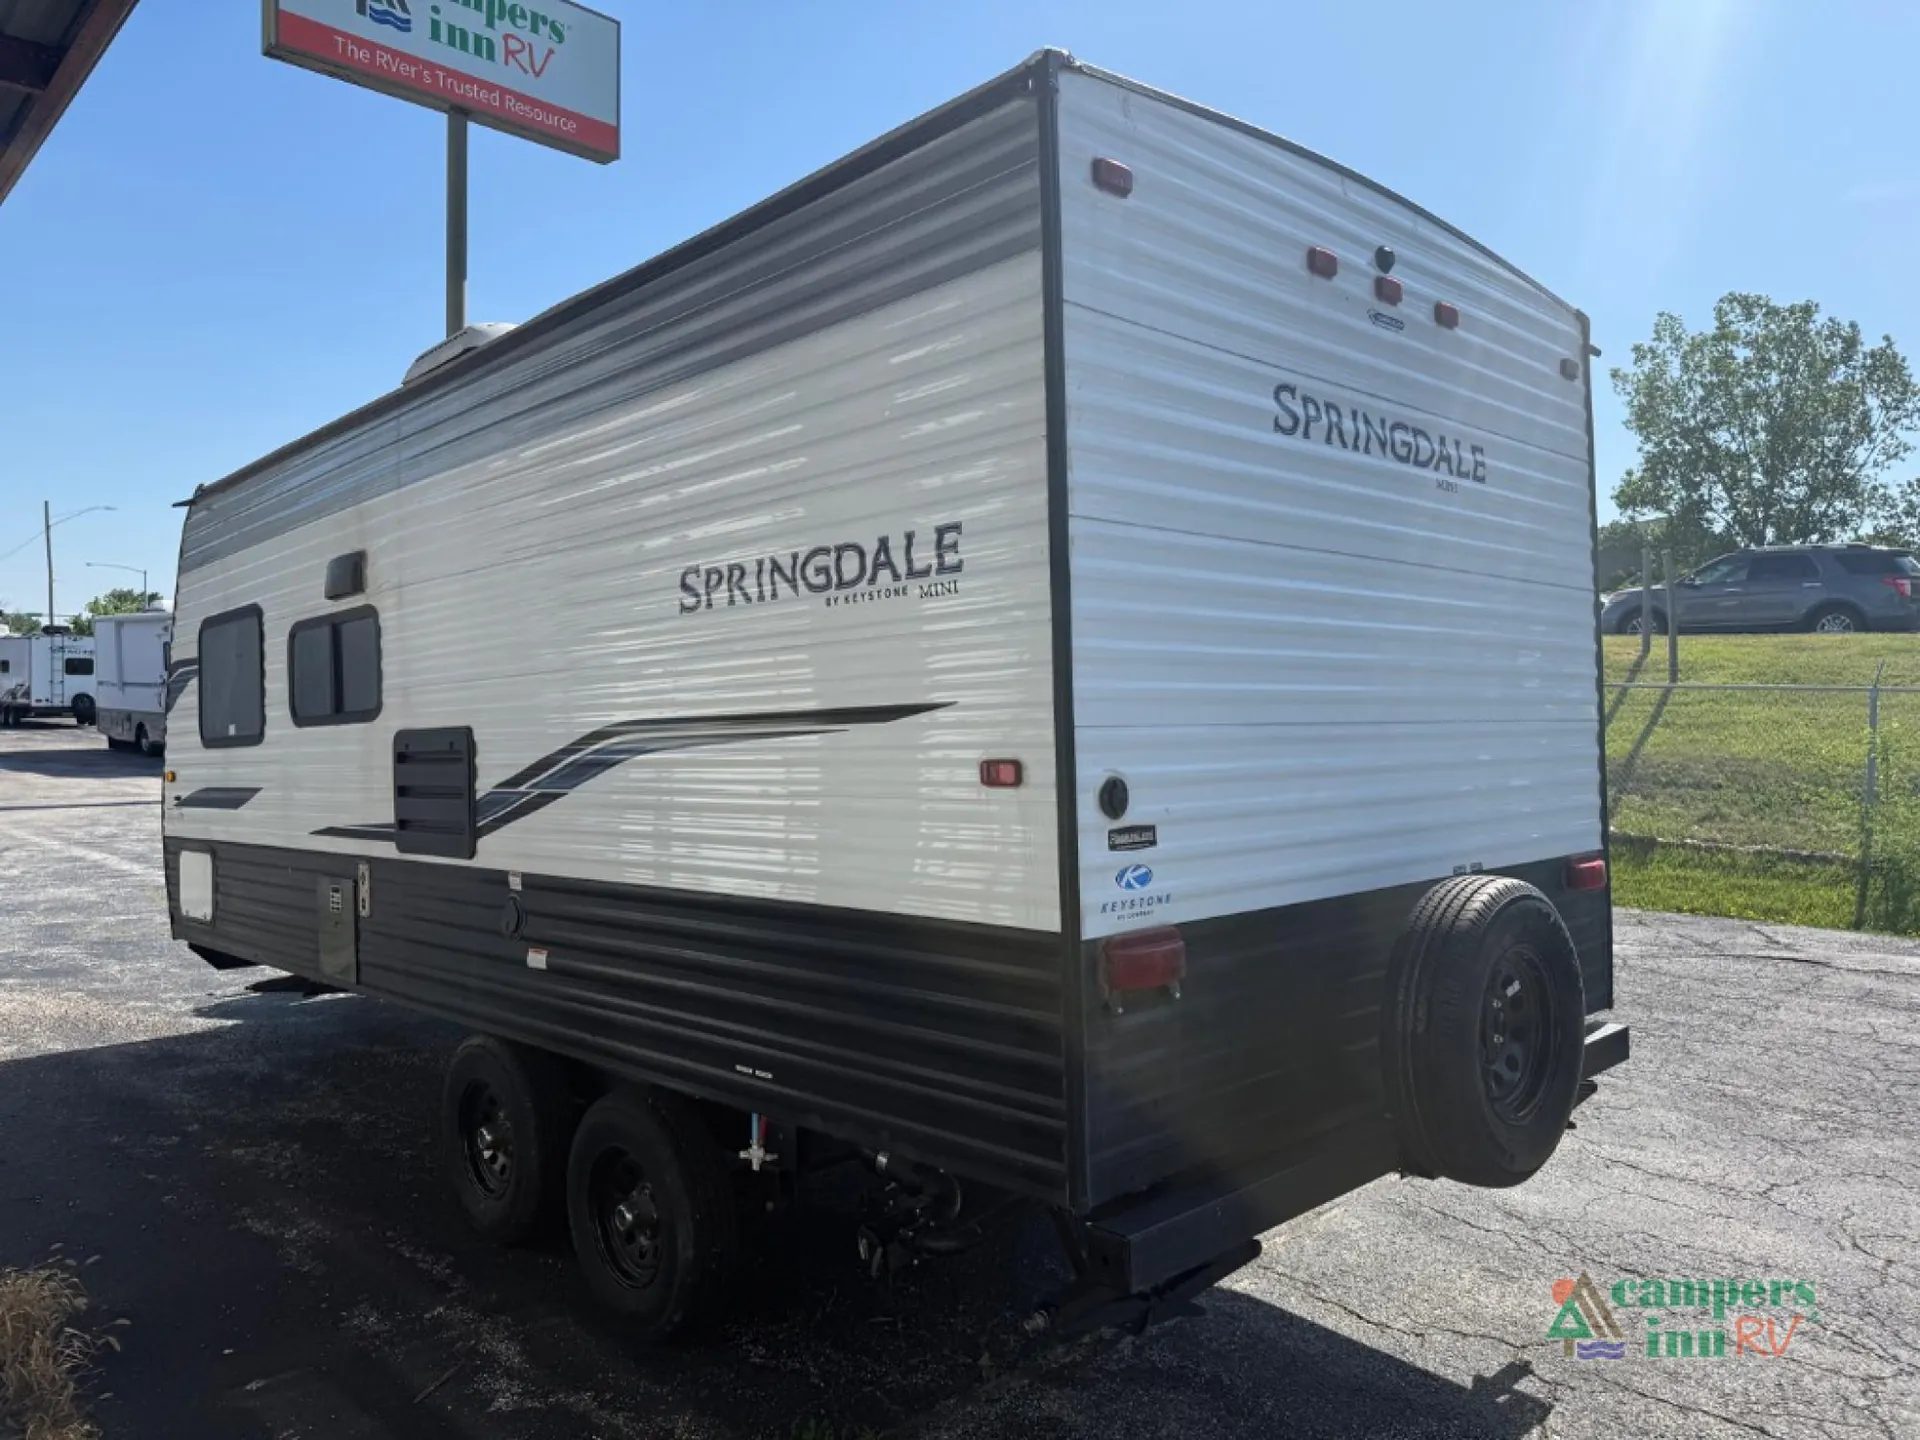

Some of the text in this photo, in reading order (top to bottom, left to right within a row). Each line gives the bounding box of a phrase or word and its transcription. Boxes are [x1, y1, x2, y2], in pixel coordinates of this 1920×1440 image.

[429, 4, 555, 79] inn RV
[451, 0, 565, 44] pers
[334, 35, 577, 133] The RVer's Trusted Resource
[1272, 383, 1486, 484] SPRINGDALE
[679, 521, 964, 615] SPRINGDALE
[844, 585, 908, 604] KEYSTONE
[919, 579, 959, 599] MINI
[1100, 893, 1172, 914] KEYSTONE
